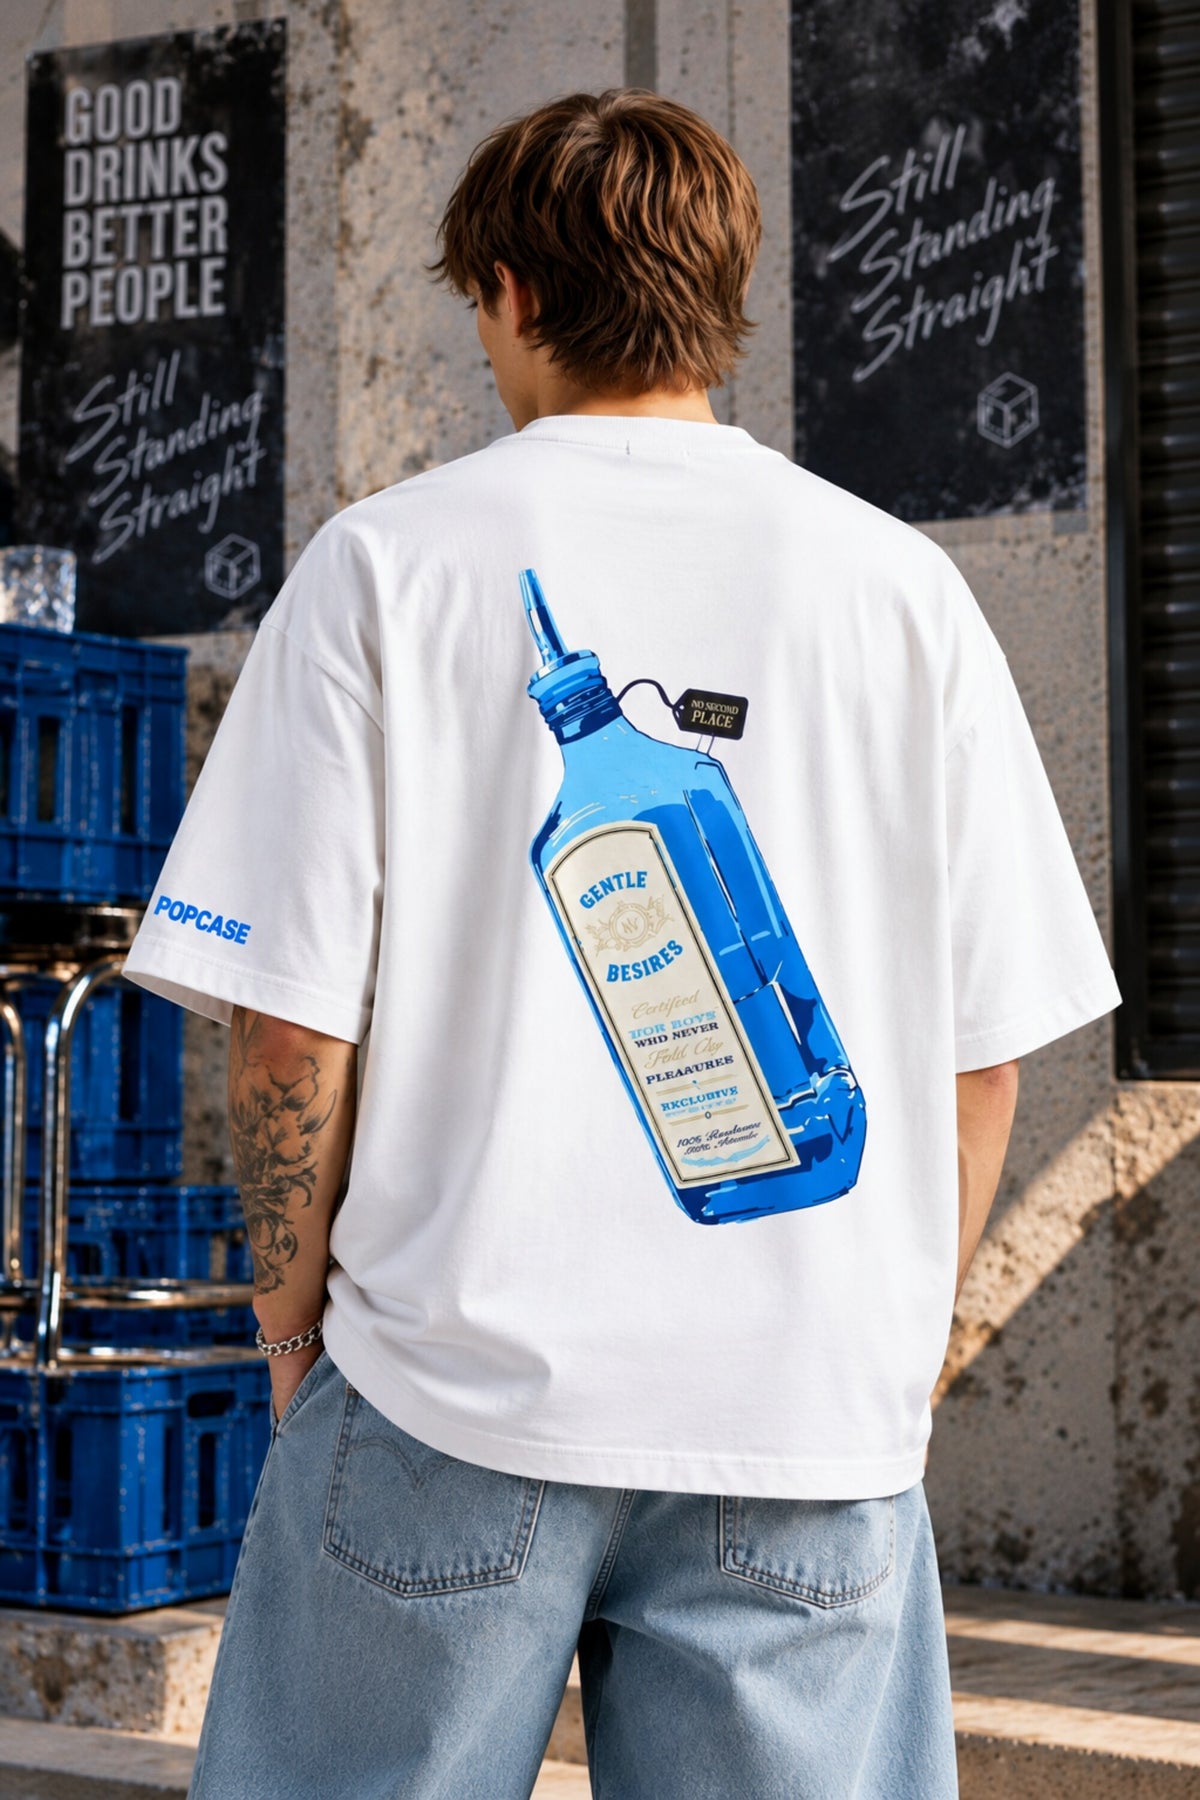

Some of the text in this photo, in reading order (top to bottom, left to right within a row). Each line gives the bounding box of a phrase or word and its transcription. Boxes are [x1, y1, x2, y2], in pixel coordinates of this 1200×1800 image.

[64, 76, 182, 145] GOOD
[63, 131, 228, 207] DRINKS
[827, 124, 967, 262] Still
[63, 195, 228, 268] BETTER
[851, 177, 1058, 313] Standing
[61, 257, 227, 330] PEOPLE
[853, 233, 1060, 384] Straight
[65, 349, 181, 464] Still
[88, 391, 263, 508] Standing
[91, 441, 267, 564] Straight
[691, 710, 734, 728] PLACE
[154, 895, 251, 945] POPCASE
[579, 870, 648, 909] GENTLE
[606, 939, 683, 982] BESIRES
[672, 1022, 719, 1040] NEVER
